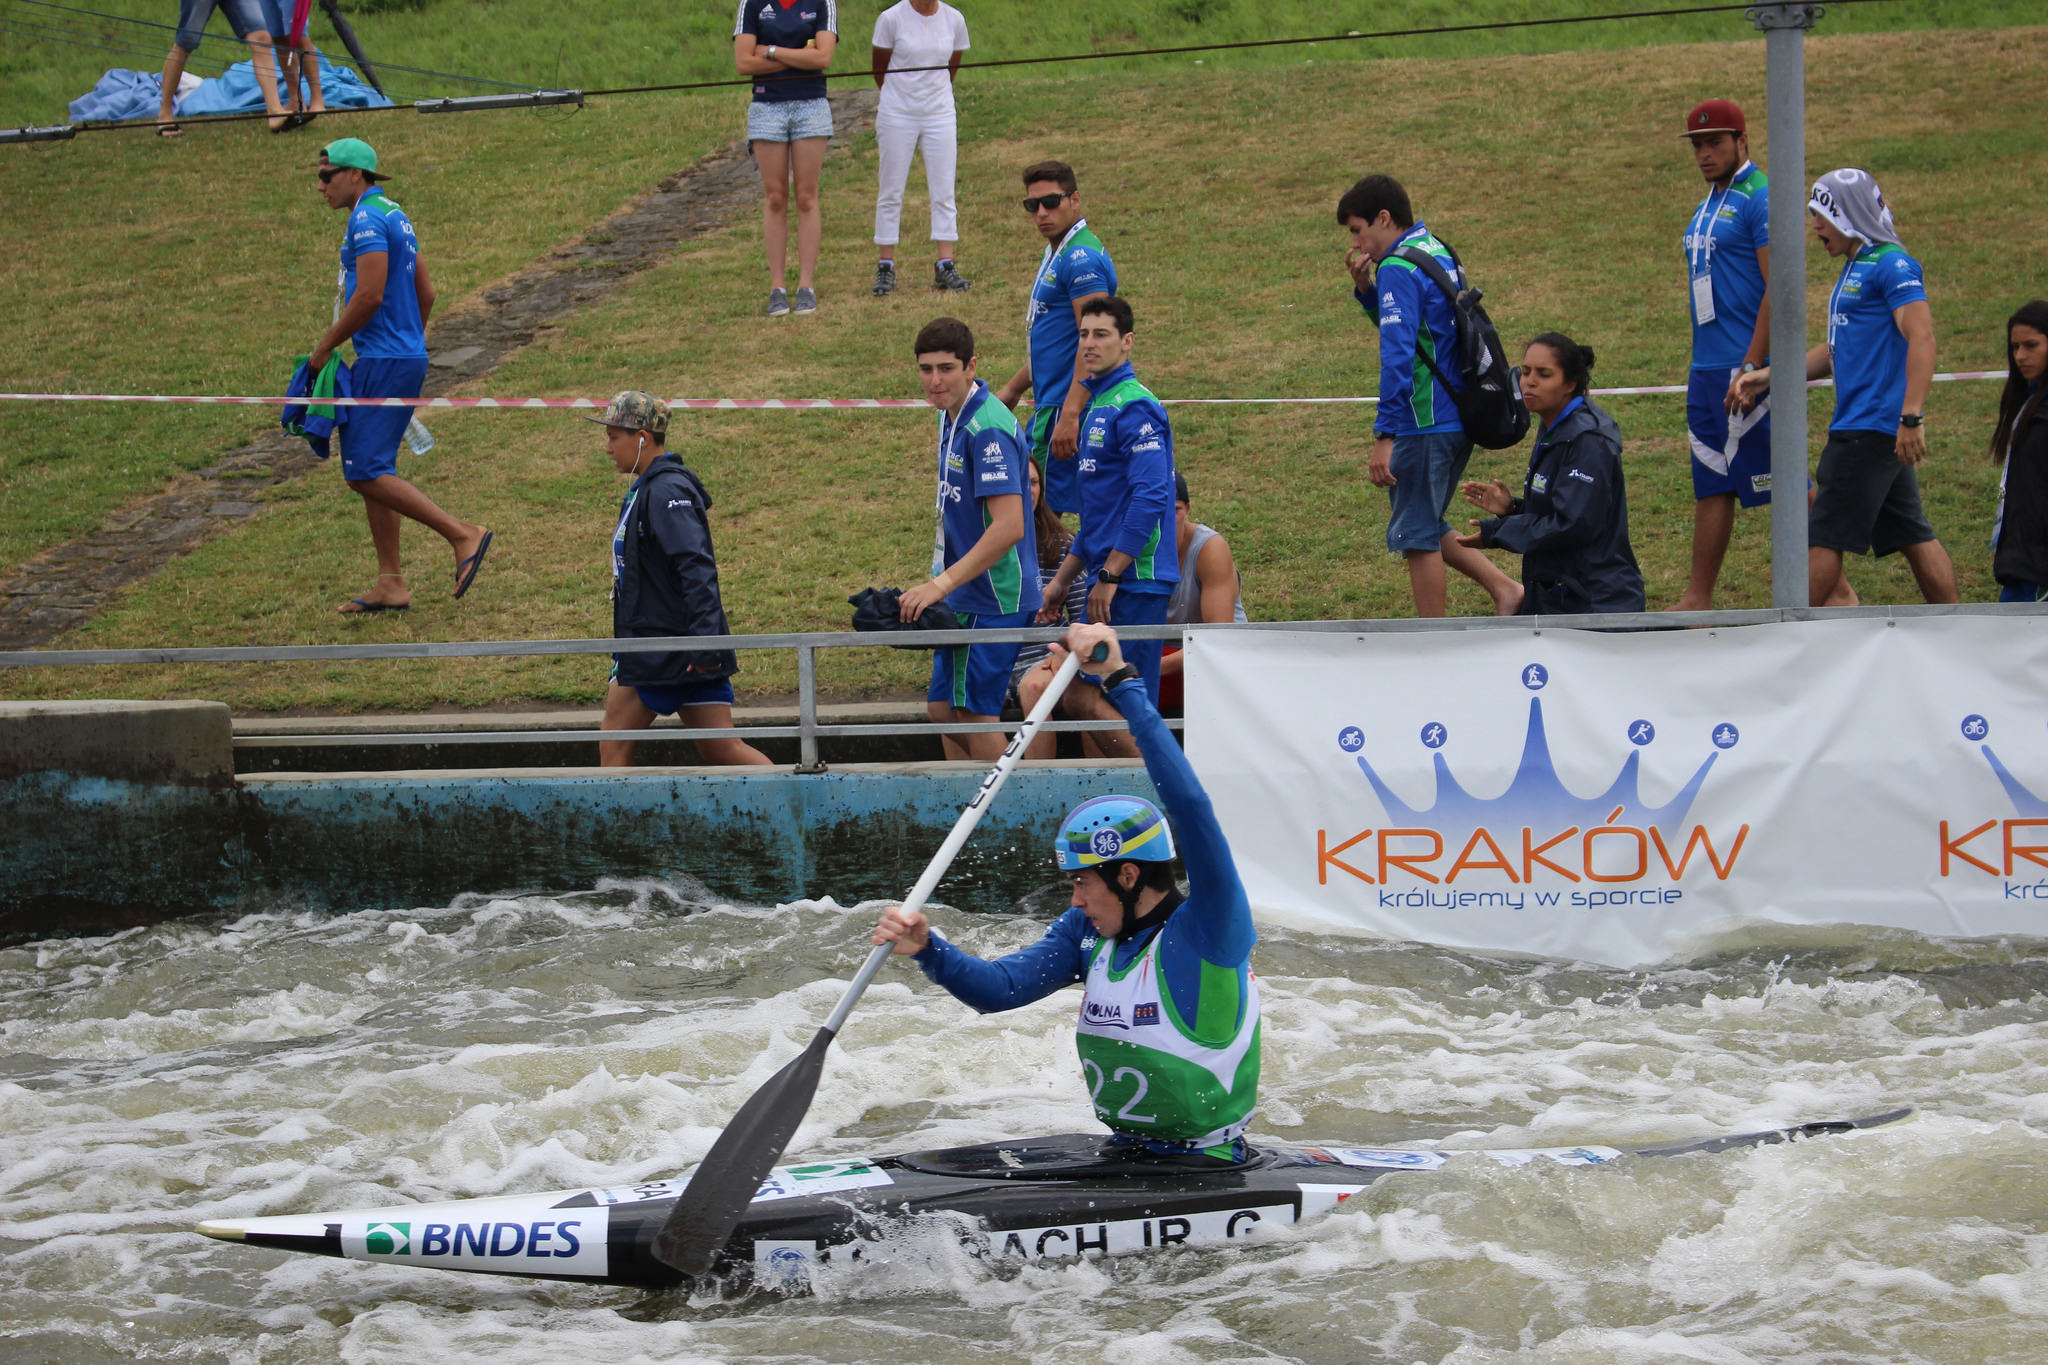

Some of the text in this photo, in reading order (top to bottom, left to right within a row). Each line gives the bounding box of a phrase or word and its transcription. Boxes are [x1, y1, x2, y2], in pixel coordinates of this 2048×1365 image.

[1317, 805, 1750, 885] KRAKÓW
[1379, 886, 1683, 910] królujemy w sporcie
[1086, 1001, 1121, 1018] KOLNA
[1083, 1058, 1157, 1124] 22
[421, 1220, 581, 1258] BNDES
